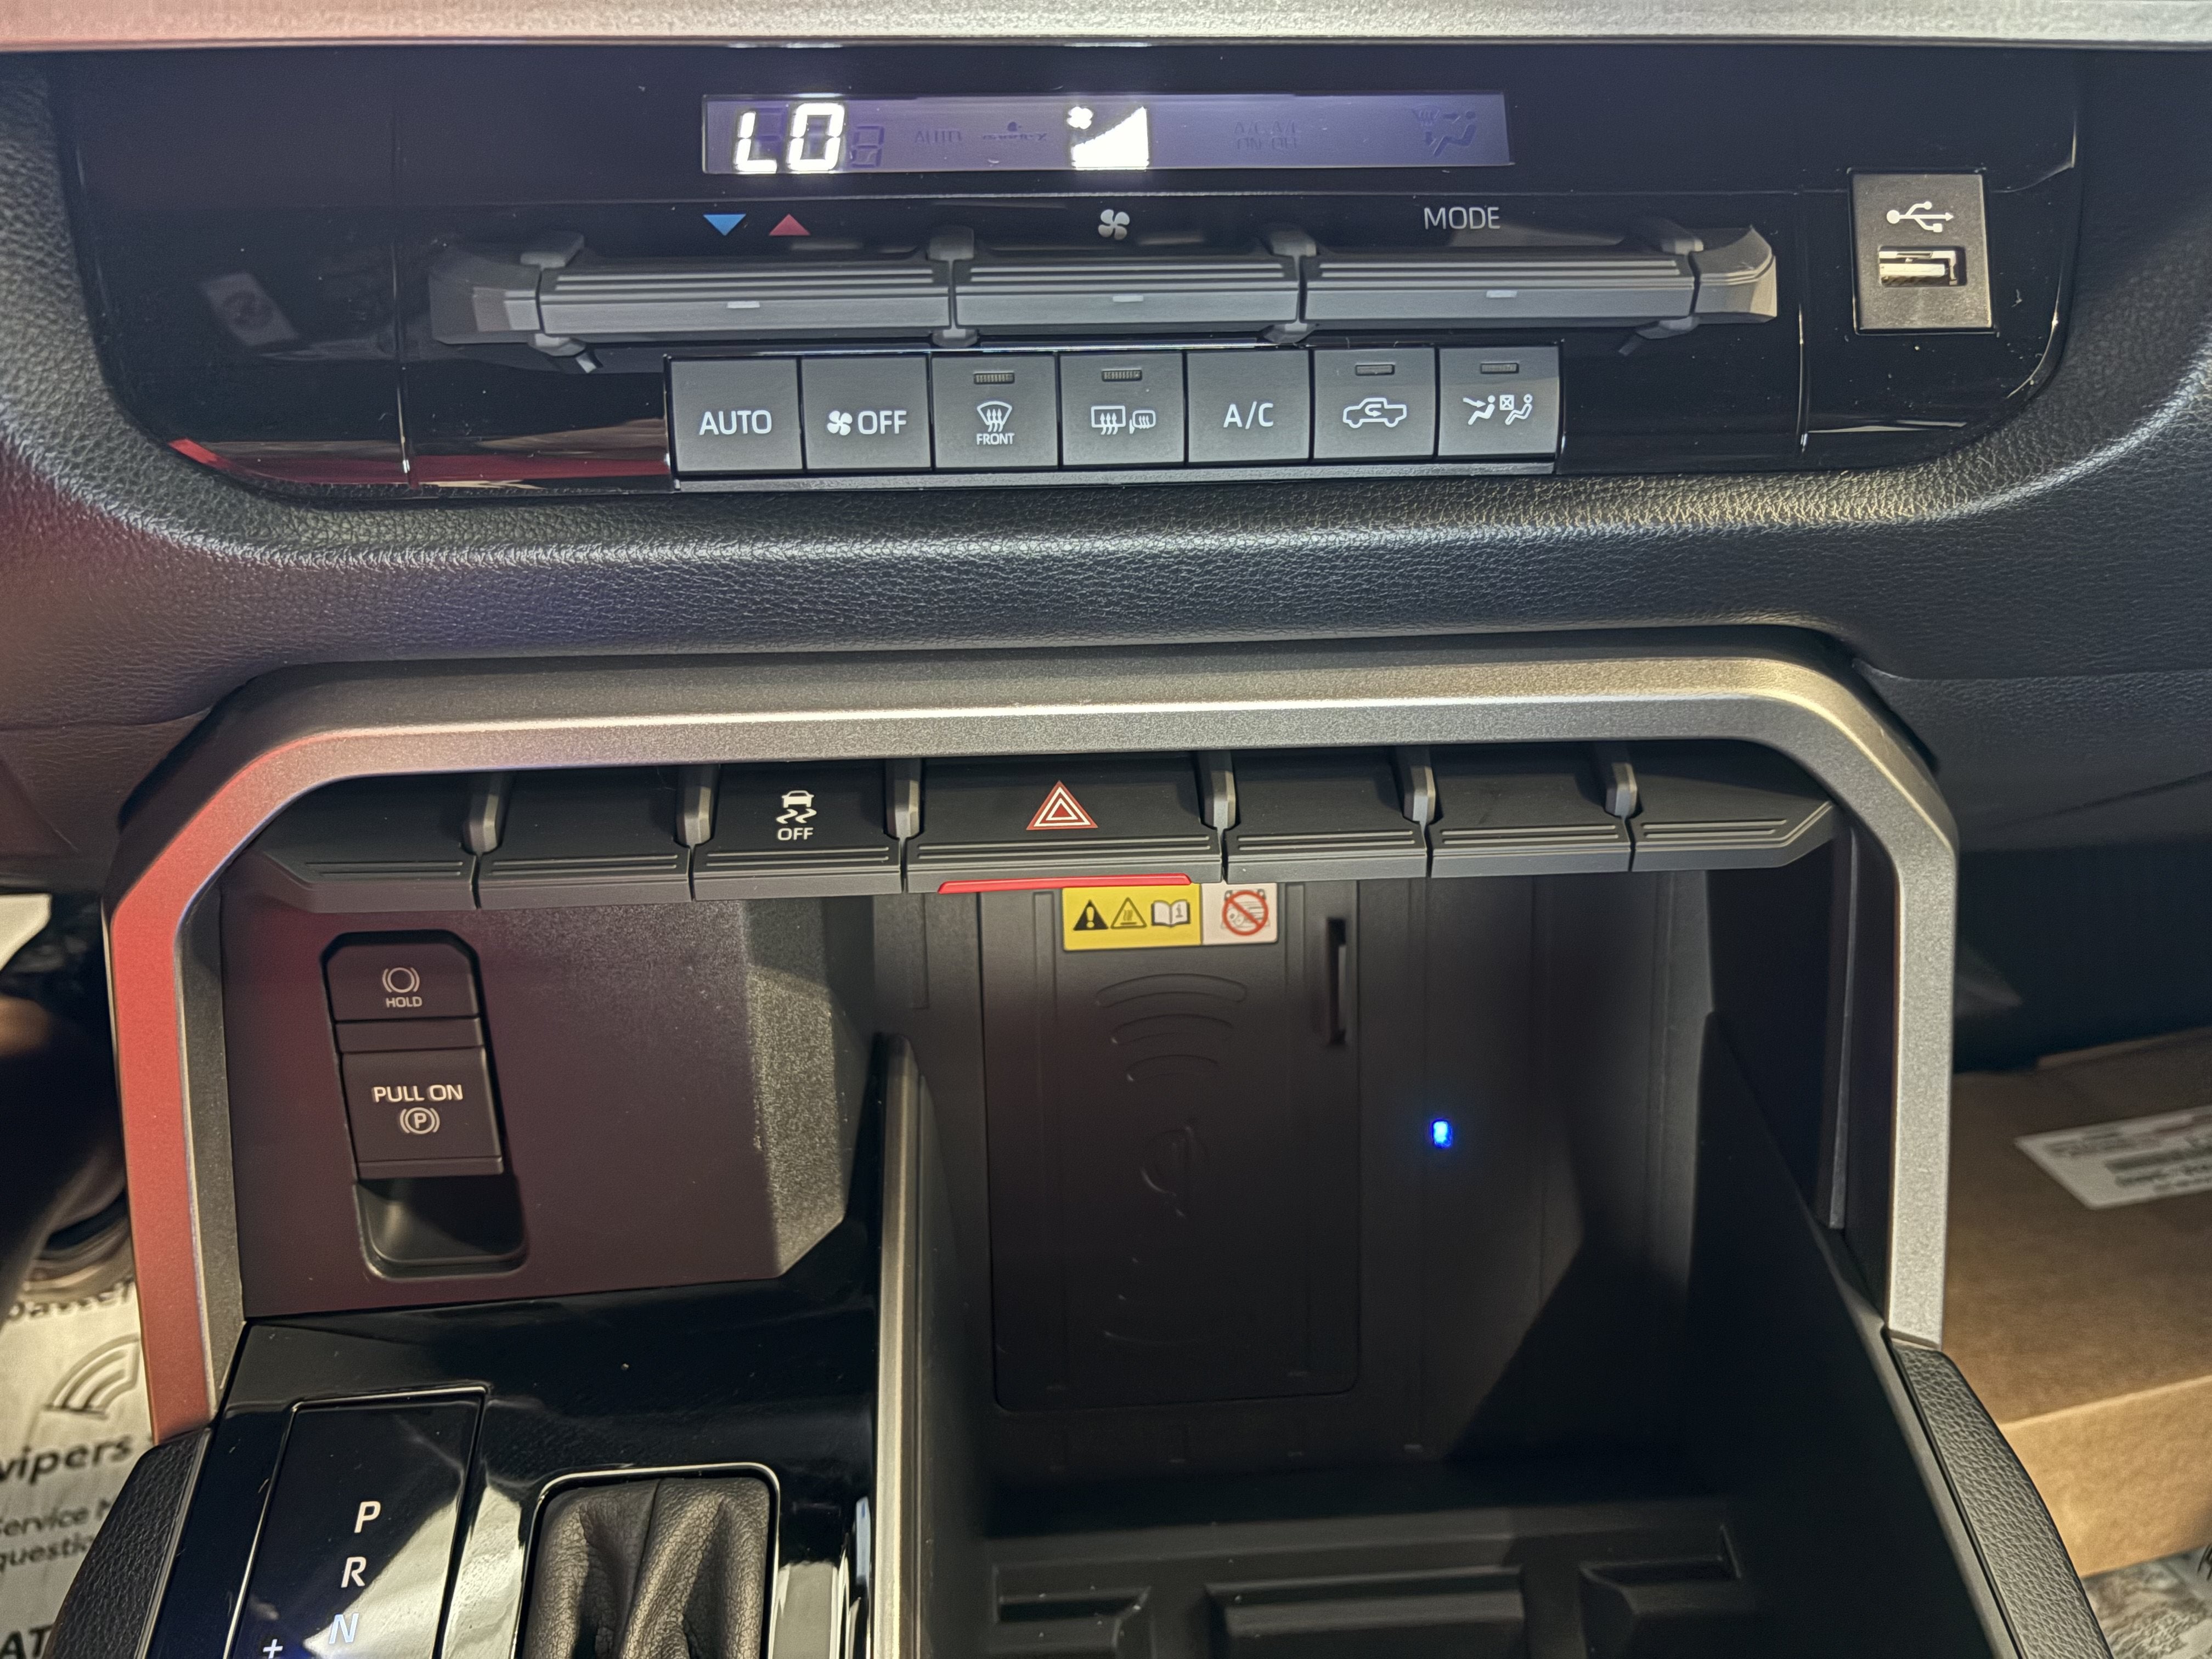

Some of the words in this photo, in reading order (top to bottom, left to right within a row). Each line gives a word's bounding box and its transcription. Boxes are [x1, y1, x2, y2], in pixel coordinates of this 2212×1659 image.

[734, 103, 845, 173] LO
[1424, 206, 1501, 230] MODE
[699, 410, 772, 436] AUTO
[857, 410, 907, 435] OFF
[1223, 401, 1274, 430] A/C
[976, 432, 1015, 445] FRONT
[777, 827, 814, 841] OFF
[385, 996, 423, 1008] HOLD
[373, 1086, 425, 1103] PULL
[428, 1084, 464, 1101] ON
[354, 1501, 381, 1533] P
[341, 1556, 366, 1588] R
[329, 1613, 359, 1644] N
